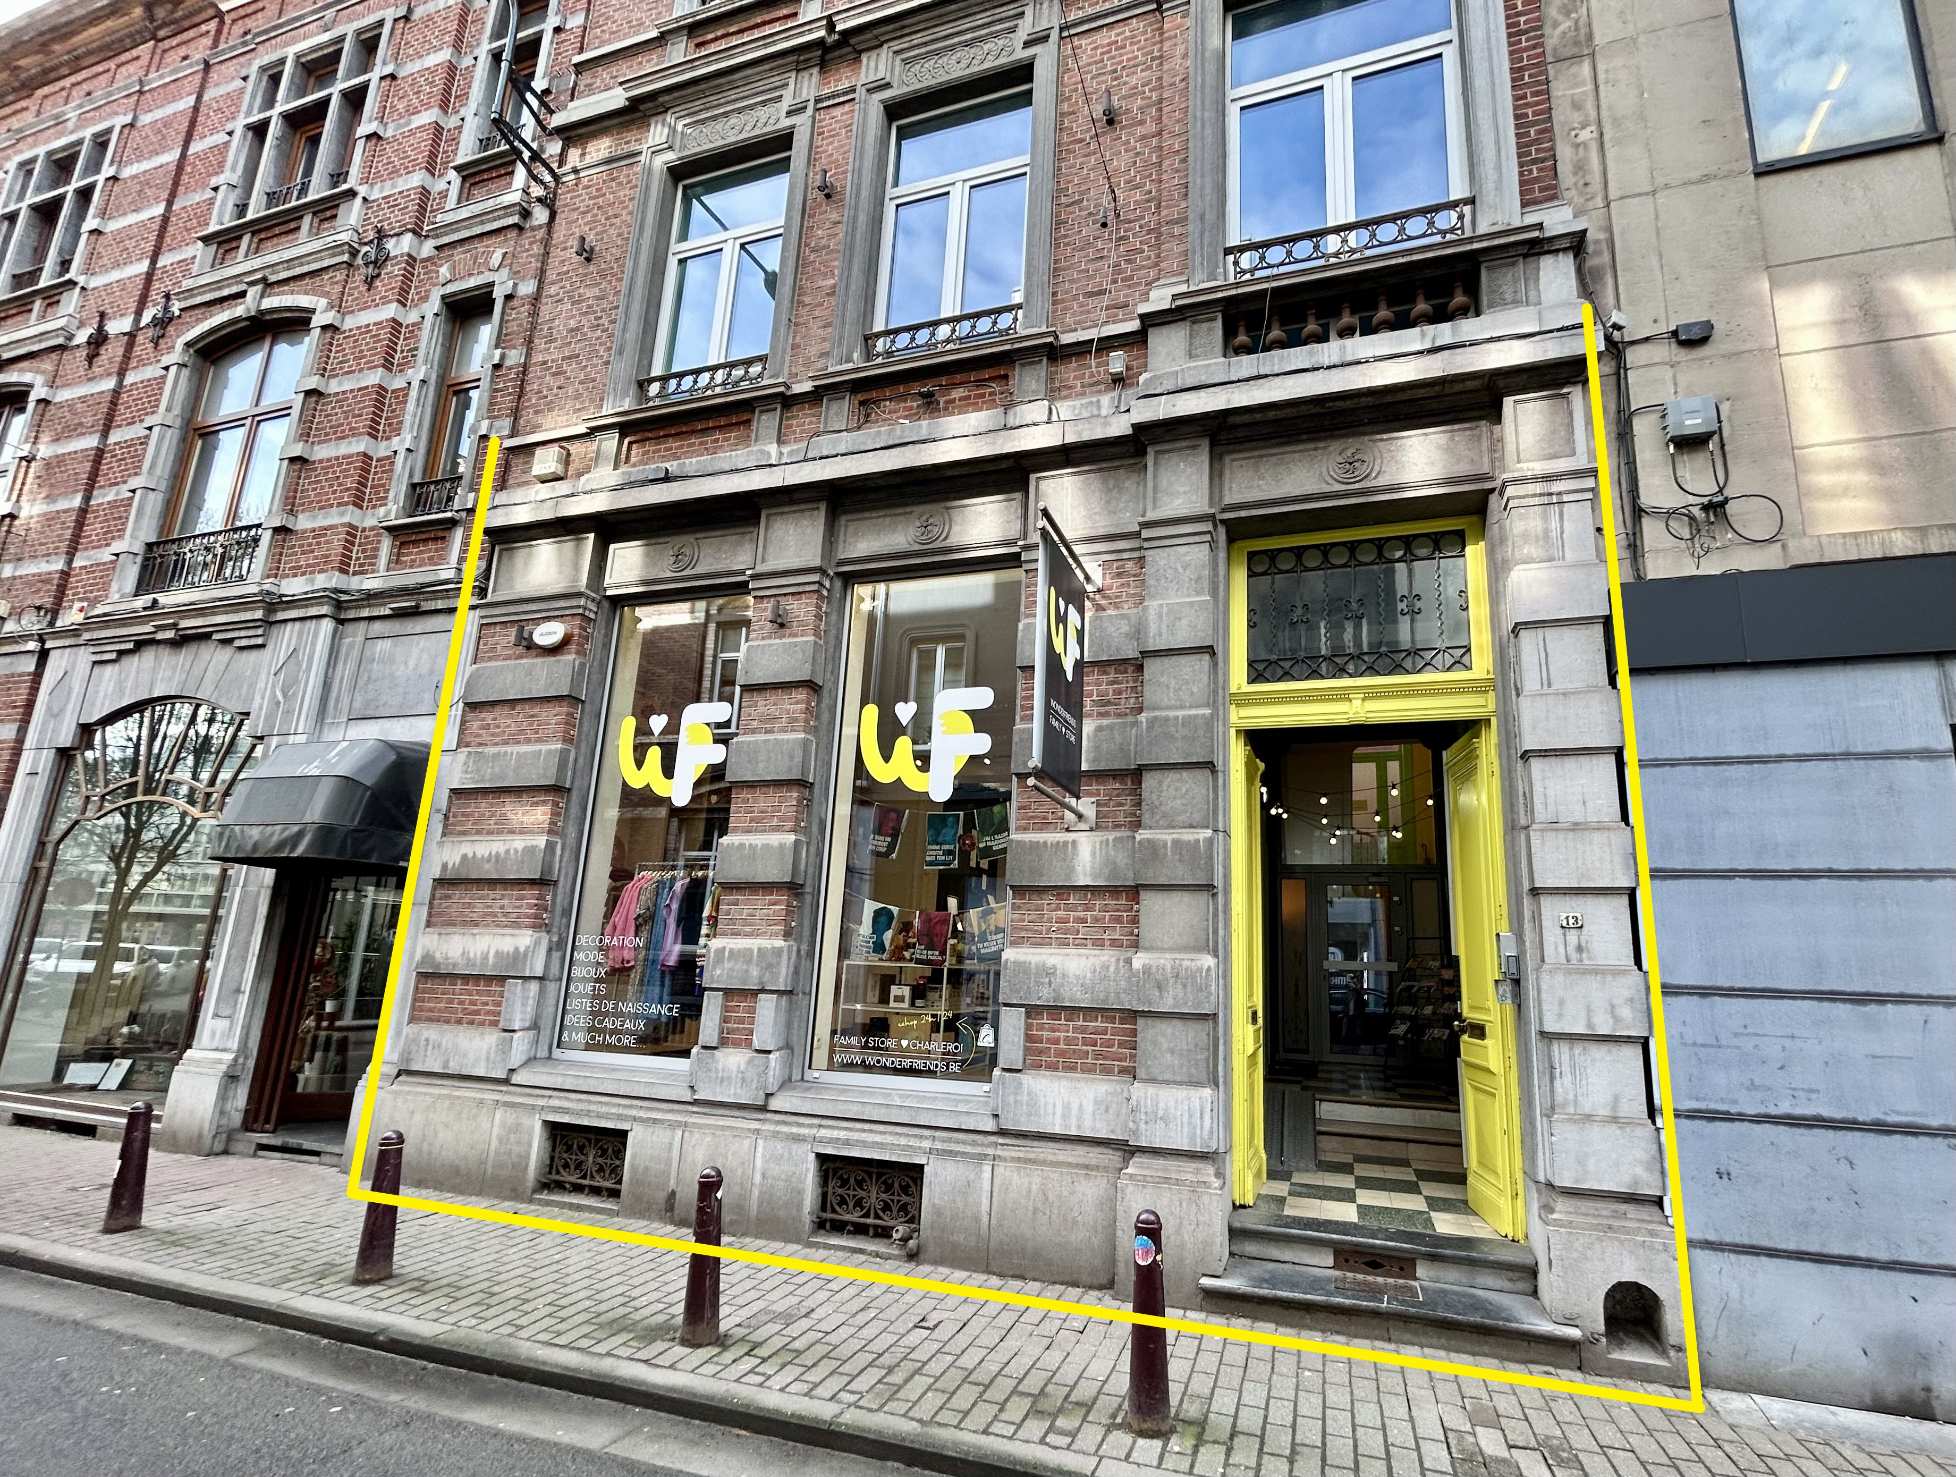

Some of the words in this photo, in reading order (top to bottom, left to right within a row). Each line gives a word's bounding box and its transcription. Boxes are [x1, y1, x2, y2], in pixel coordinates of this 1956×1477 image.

[1564, 915, 1580, 926] 13
[575, 935, 644, 947] DECORATION
[573, 951, 606, 962] MODE
[570, 967, 608, 978] BIJOUX
[568, 983, 607, 995] JOUETS
[566, 999, 600, 1011] LISTES
[601, 1000, 616, 1012] DE
[617, 1001, 681, 1016] NAISSANCE
[563, 1014, 593, 1027] IDEES
[594, 1016, 646, 1031] CADEAUX
[561, 1030, 569, 1042] &
[571, 1031, 604, 1045] MUCH
[833, 1034, 867, 1047] FAMILY
[868, 1037, 899, 1049] STORE
[909, 1040, 963, 1053] CHARLEROI
[832, 1053, 962, 1073] WWW.WONDERFRIENDS.BE
